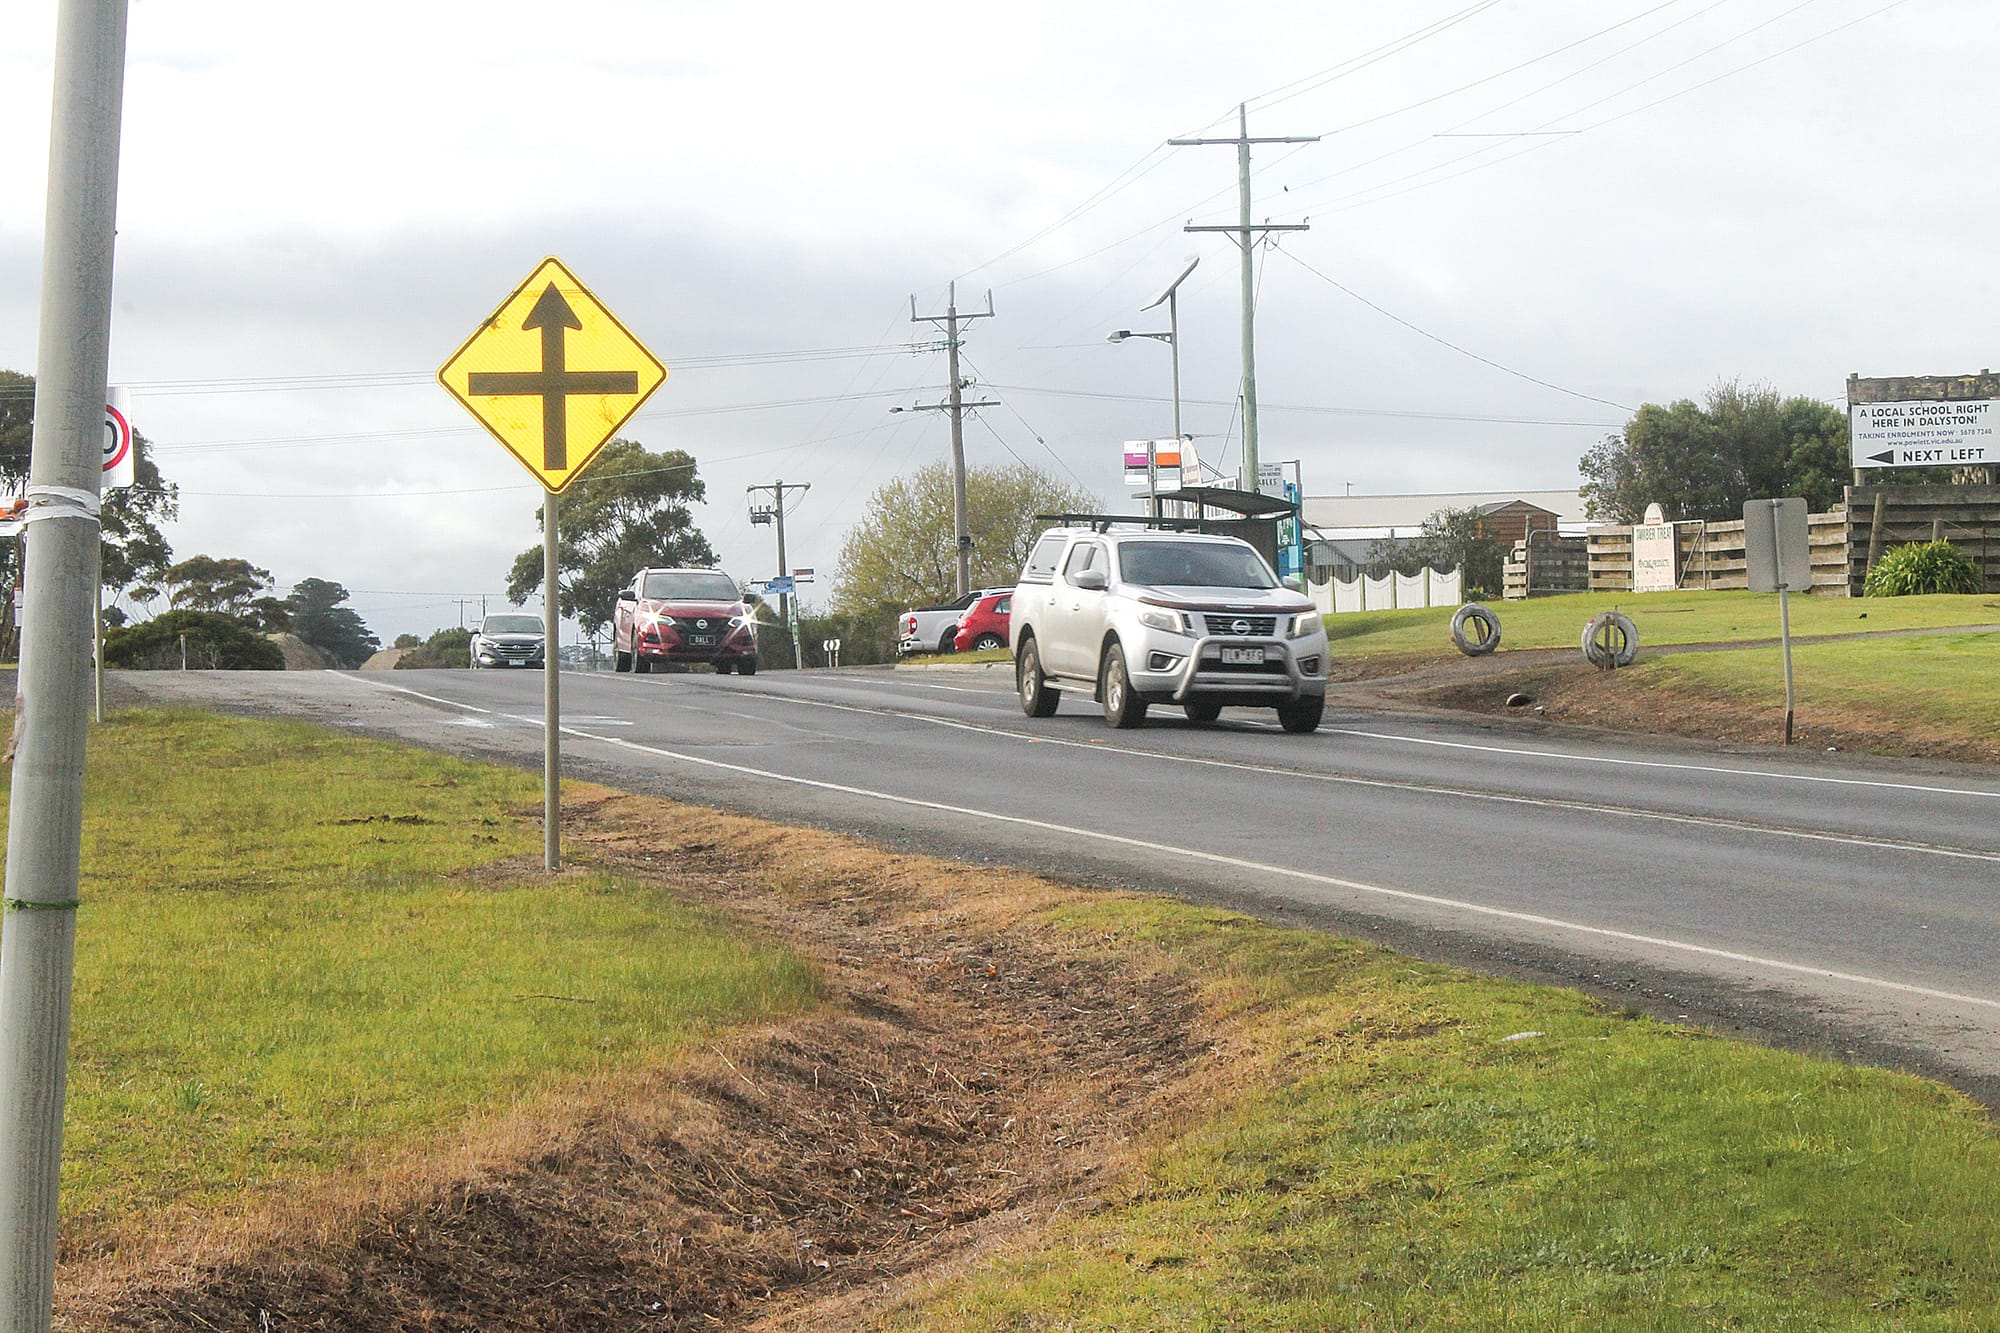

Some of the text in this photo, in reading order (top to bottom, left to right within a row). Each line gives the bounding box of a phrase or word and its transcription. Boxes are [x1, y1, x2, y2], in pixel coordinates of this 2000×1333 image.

[1860, 404, 1989, 418] A LOCAL SCHOOL RIGHT
[1872, 416, 1977, 428] HERE IN DALYSTON!
[1888, 430, 1934, 438] ENROLMENTS
[1903, 448, 1985, 462] NEXT LEFT
